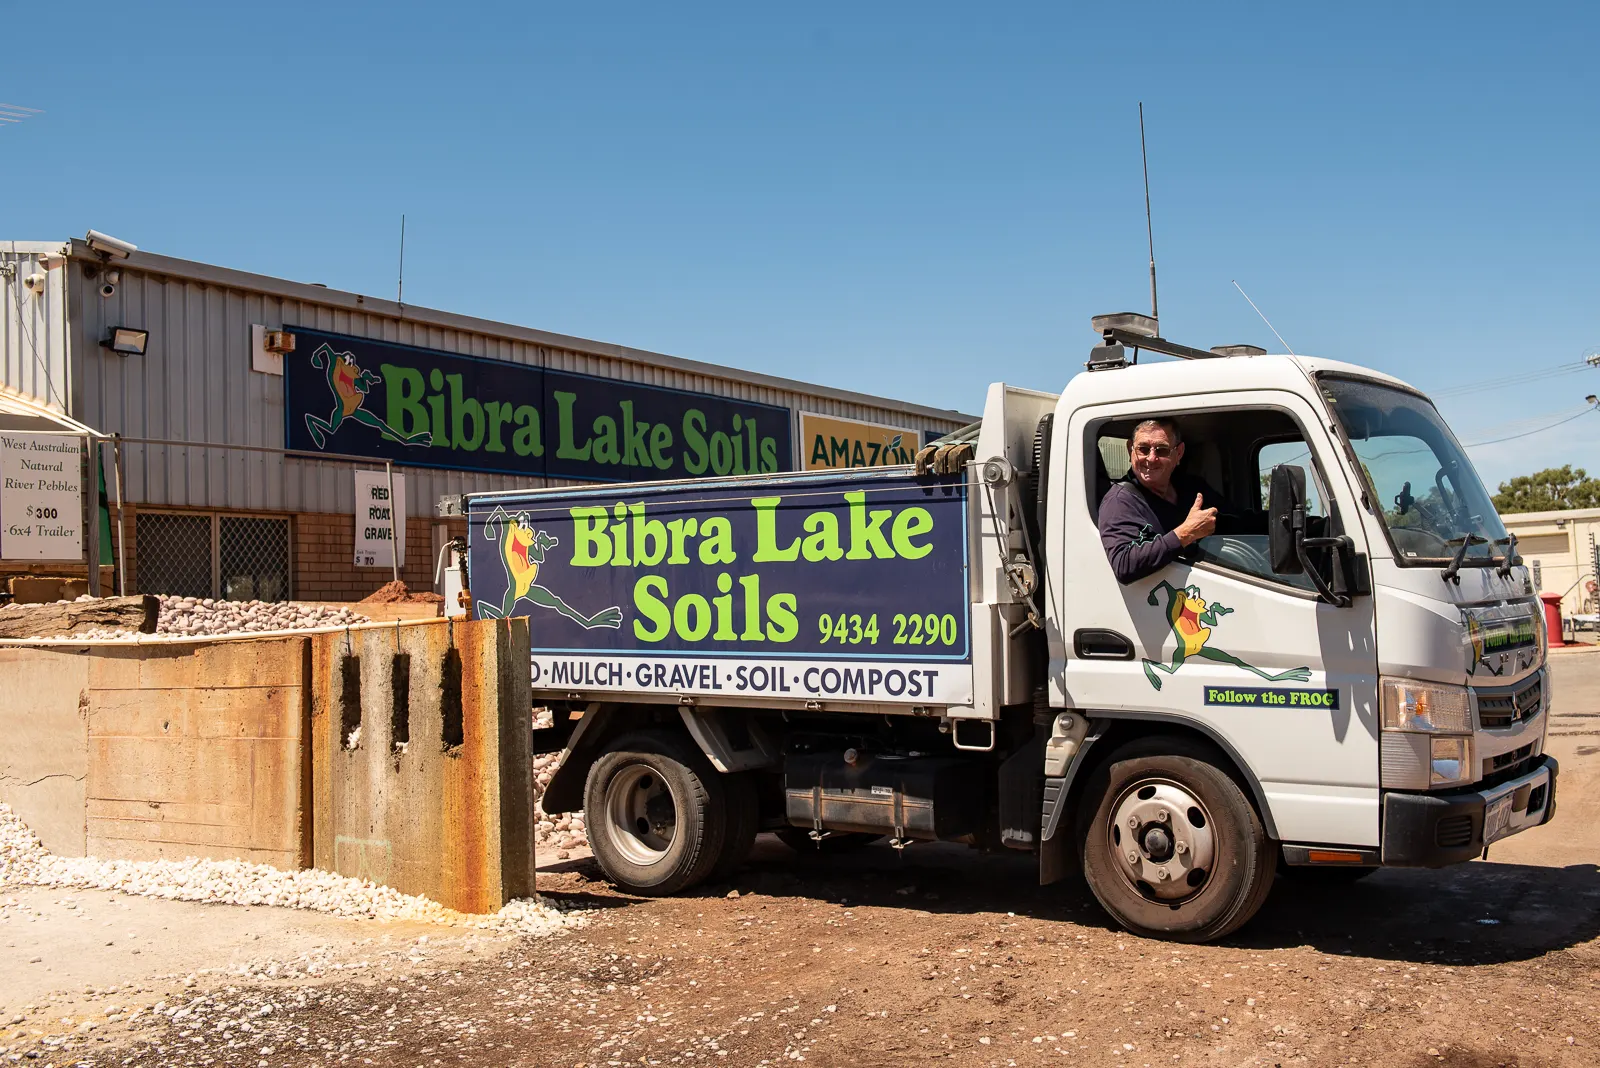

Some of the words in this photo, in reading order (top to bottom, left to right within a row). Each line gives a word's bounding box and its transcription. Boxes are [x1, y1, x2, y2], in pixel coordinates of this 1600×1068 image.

[380, 363, 544, 458] Bibra
[554, 390, 673, 471] Lake
[683, 408, 778, 475] Soils
[2, 438, 27, 450] West
[29, 440, 79, 454] Australian
[811, 434, 915, 468] AMAZON
[20, 459, 63, 472] Natural
[5, 477, 34, 490] River
[38, 479, 78, 492] Pebbles
[371, 487, 390, 500] RED
[36, 507, 58, 519] 300
[9, 524, 31, 537] 6x4
[36, 525, 75, 537] Trailer
[364, 526, 397, 541] GRAVE
[569, 501, 736, 567] Bibra
[751, 489, 934, 563] Lake
[633, 572, 799, 643] Soils
[818, 613, 880, 645] 9434
[893, 613, 957, 646] 2290
[551, 661, 624, 687] MULCH
[635, 662, 722, 690] GRAVEL
[736, 665, 791, 693] SOIL
[803, 667, 939, 698] COMPOST
[1208, 689, 1258, 704] Follow
[1261, 691, 1286, 705] the
[1289, 691, 1334, 706] FROG
